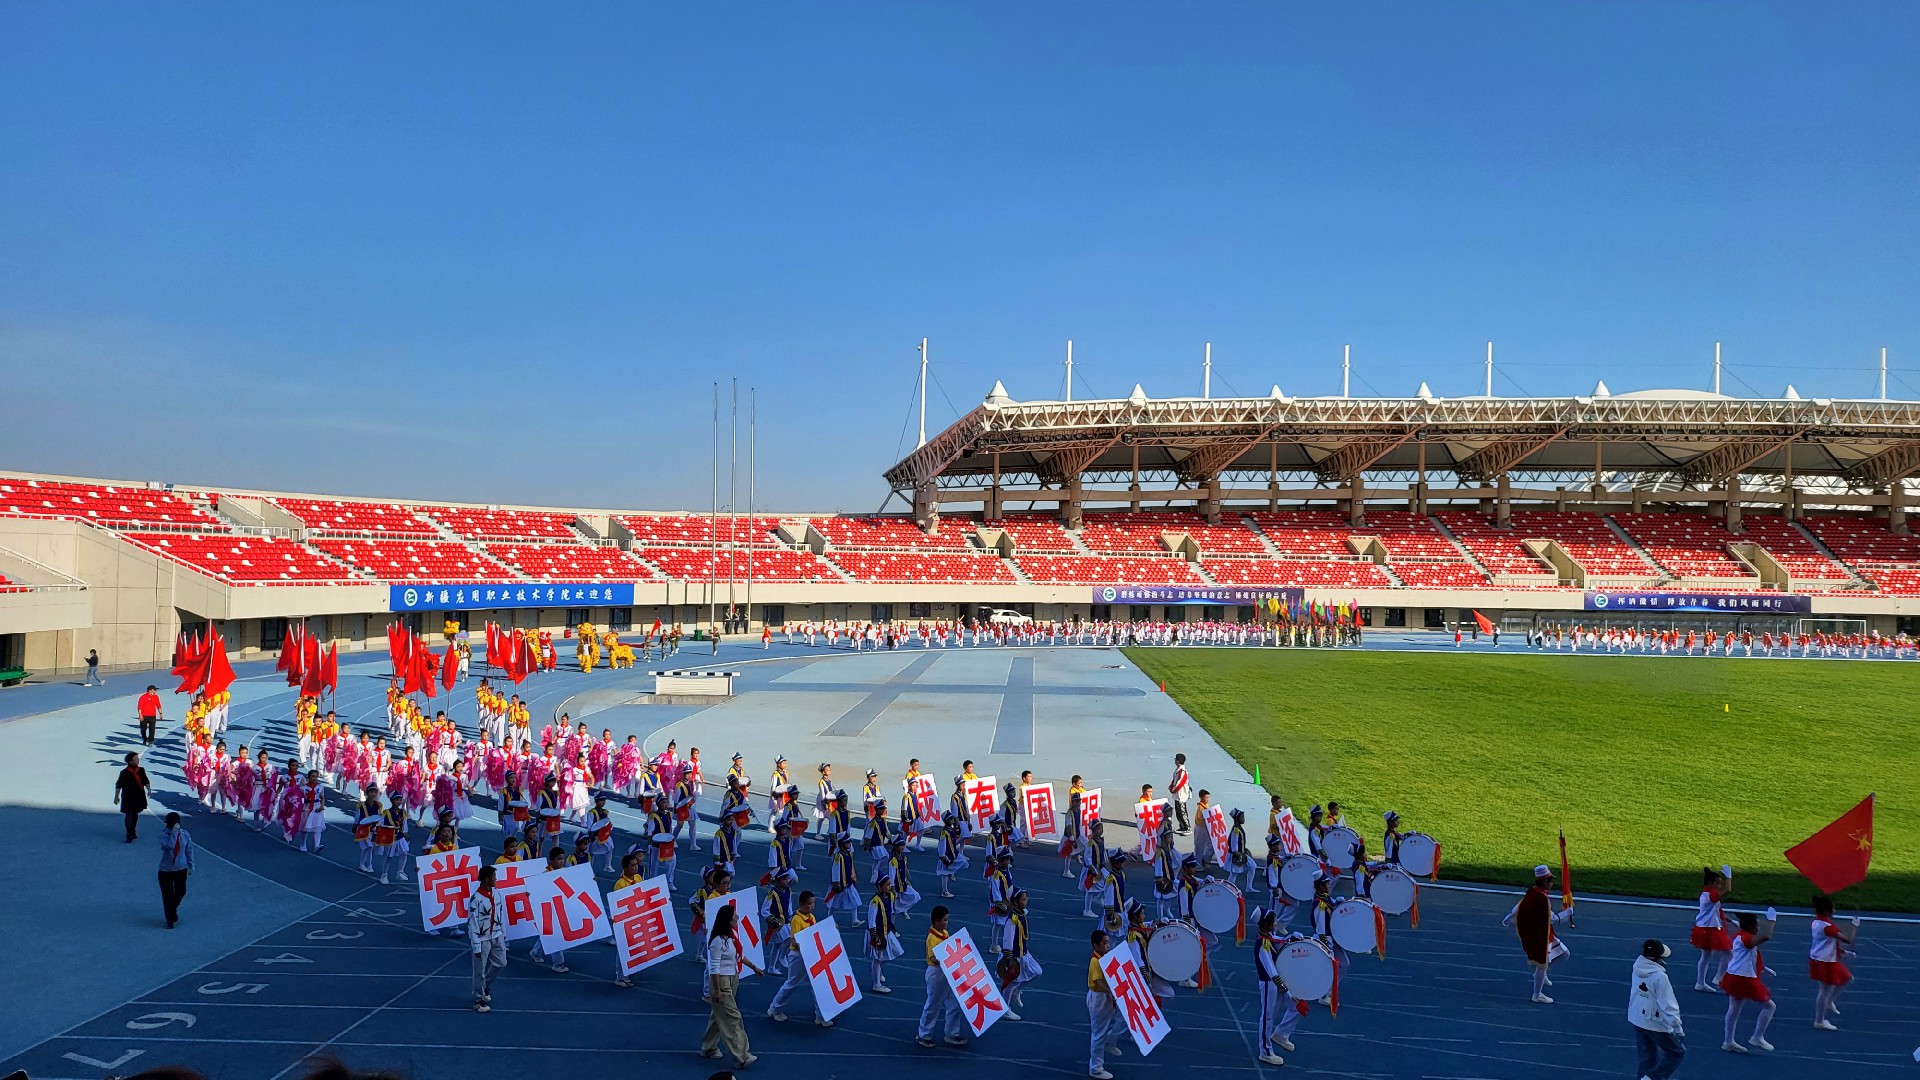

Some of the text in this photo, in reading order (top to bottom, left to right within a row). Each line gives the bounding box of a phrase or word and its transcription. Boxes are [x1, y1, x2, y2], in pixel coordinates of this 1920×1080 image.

[424, 588, 613, 605] 新疆应用职业技术学院欢迎您
[1617, 597, 1782, 608] 挥洒激情 释放青春 我们风雨同行
[907, 778, 941, 823] 我
[968, 781, 995, 829] 有
[1026, 787, 1056, 838] 国
[1207, 808, 1229, 863] 梦
[344, 907, 406, 918] 2
[423, 854, 479, 926] 党
[541, 876, 602, 942] 心
[305, 929, 365, 940] 3
[613, 886, 675, 969] 童
[253, 952, 315, 965] 4
[809, 931, 855, 1005] 七
[196, 981, 271, 995] 5
[943, 936, 1003, 1030] 美
[1106, 956, 1161, 1045] 和
[126, 1012, 197, 1030] 6
[61, 1049, 147, 1070] 7
